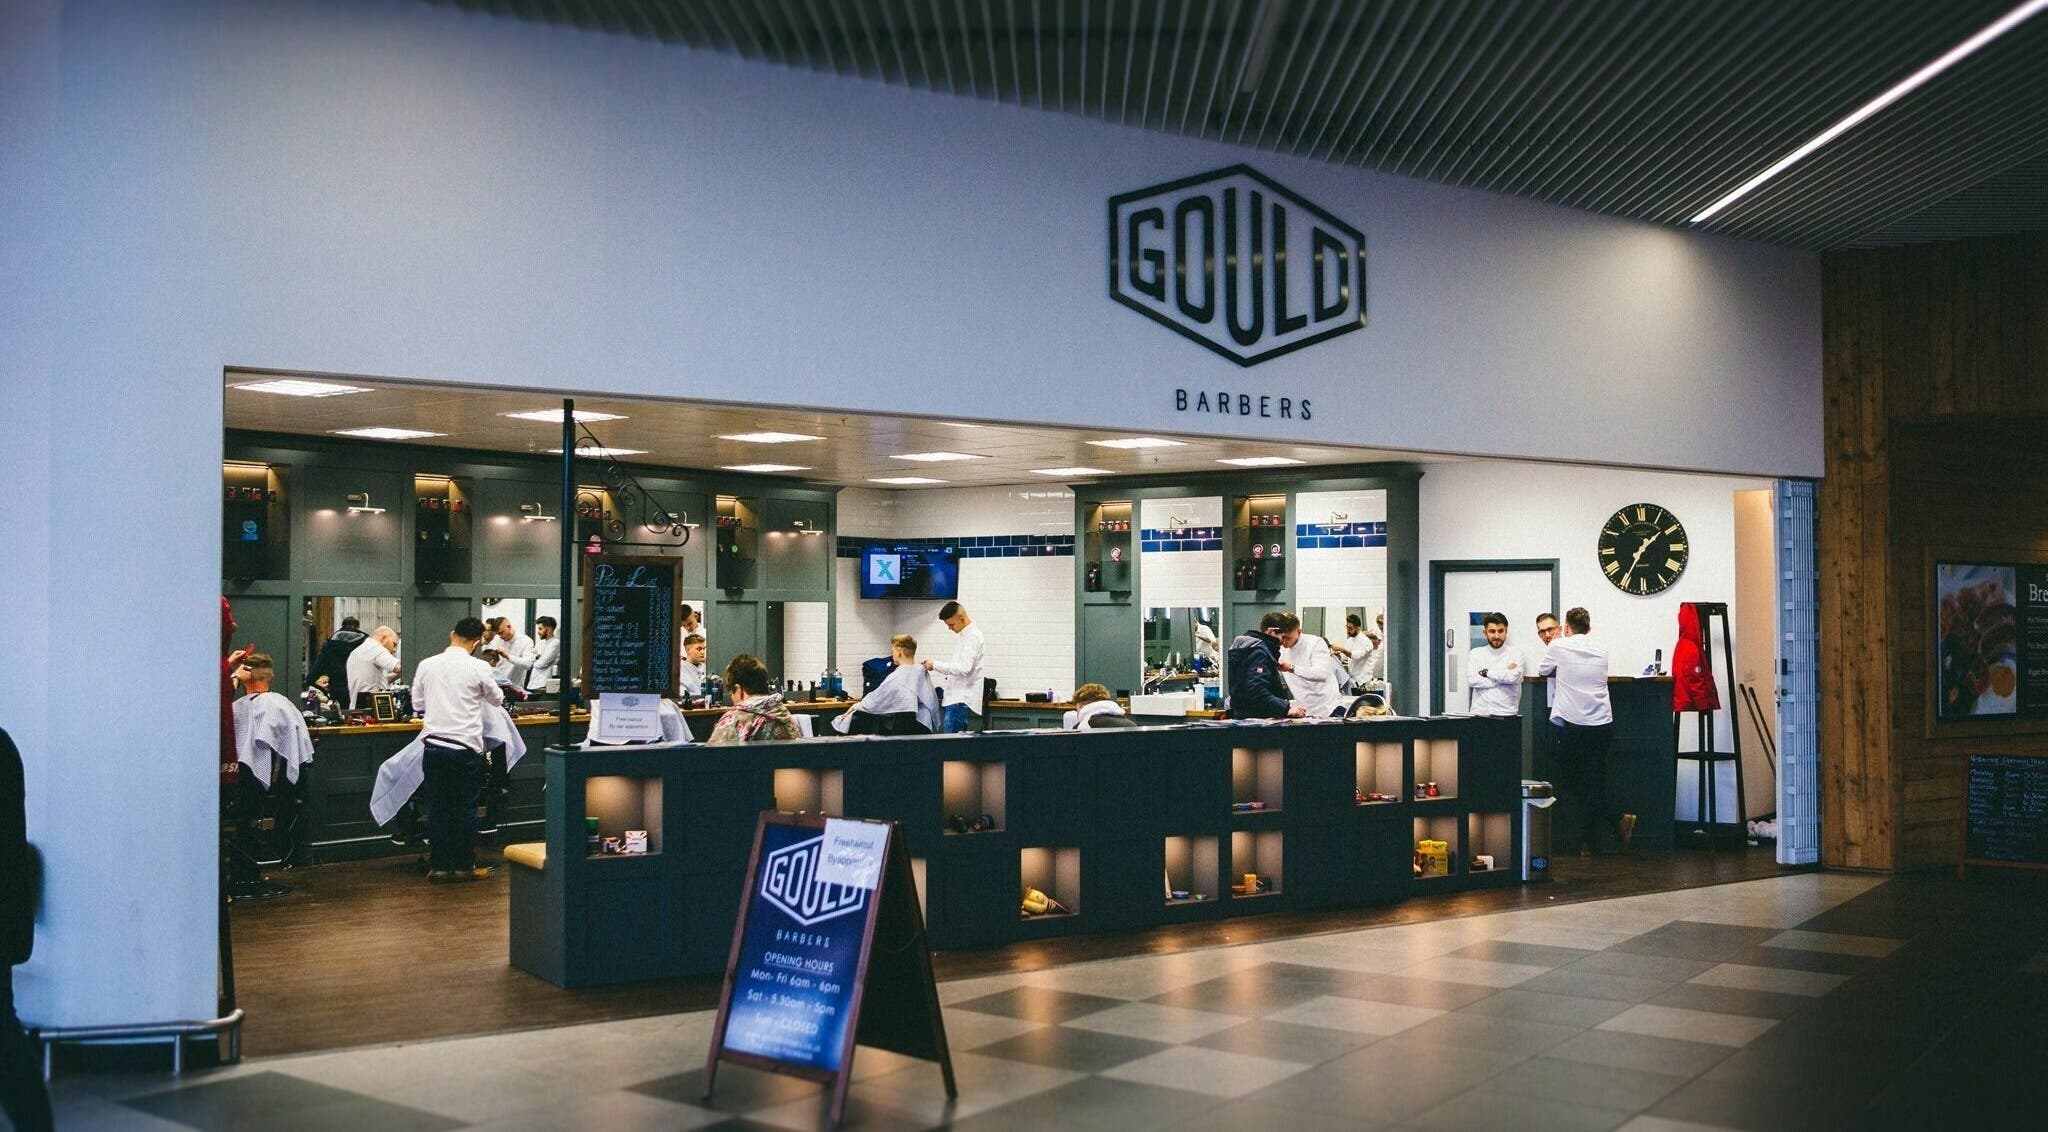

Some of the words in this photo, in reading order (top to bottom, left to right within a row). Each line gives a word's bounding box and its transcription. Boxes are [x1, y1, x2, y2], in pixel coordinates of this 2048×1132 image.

[1129, 187, 1348, 346] GOULD
[1176, 389, 1312, 420] BARBERS
[776, 929, 831, 948] BARBERS
[764, 951, 803, 967] OPENING
[804, 958, 834, 973] HOURS
[746, 988, 763, 1001] Sat
[776, 972, 788, 984] Fri
[790, 974, 810, 988] 6am
[819, 981, 841, 995] 6pm
[781, 1017, 819, 1035] CLOSED
